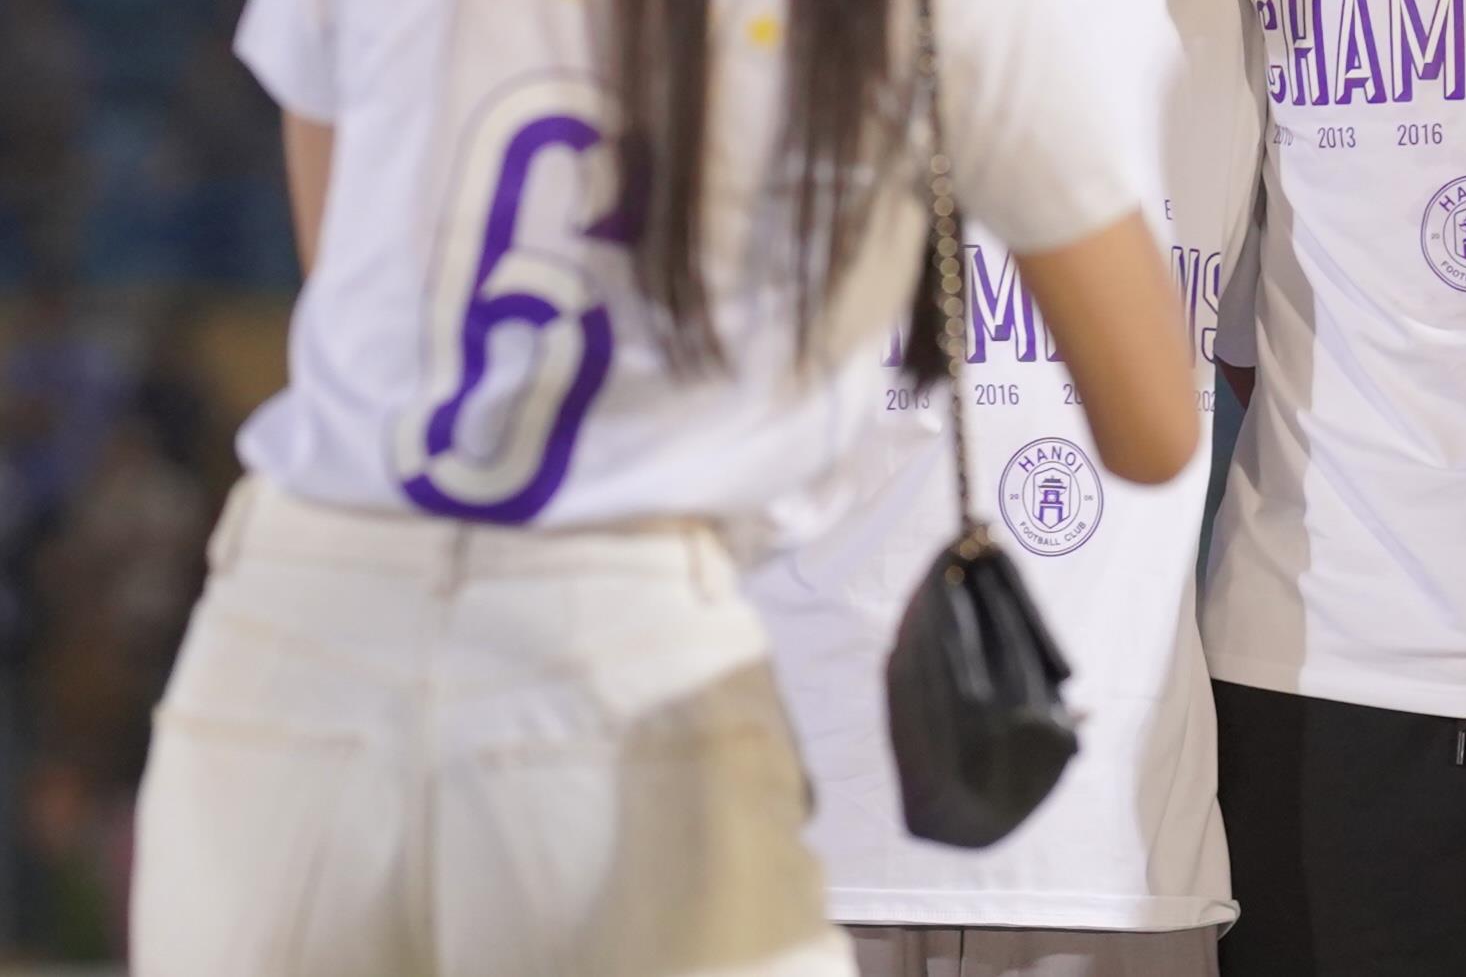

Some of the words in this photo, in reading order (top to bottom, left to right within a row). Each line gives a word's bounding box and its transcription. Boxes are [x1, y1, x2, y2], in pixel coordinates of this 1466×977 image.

[1317, 126, 1356, 149] 2013
[1397, 123, 1443, 146] 2016
[975, 384, 1019, 405] 2016
[1018, 446, 1083, 473] HANOI
[1020, 521, 1060, 545] FOOTBALL
[1064, 521, 1086, 541] CLUB
